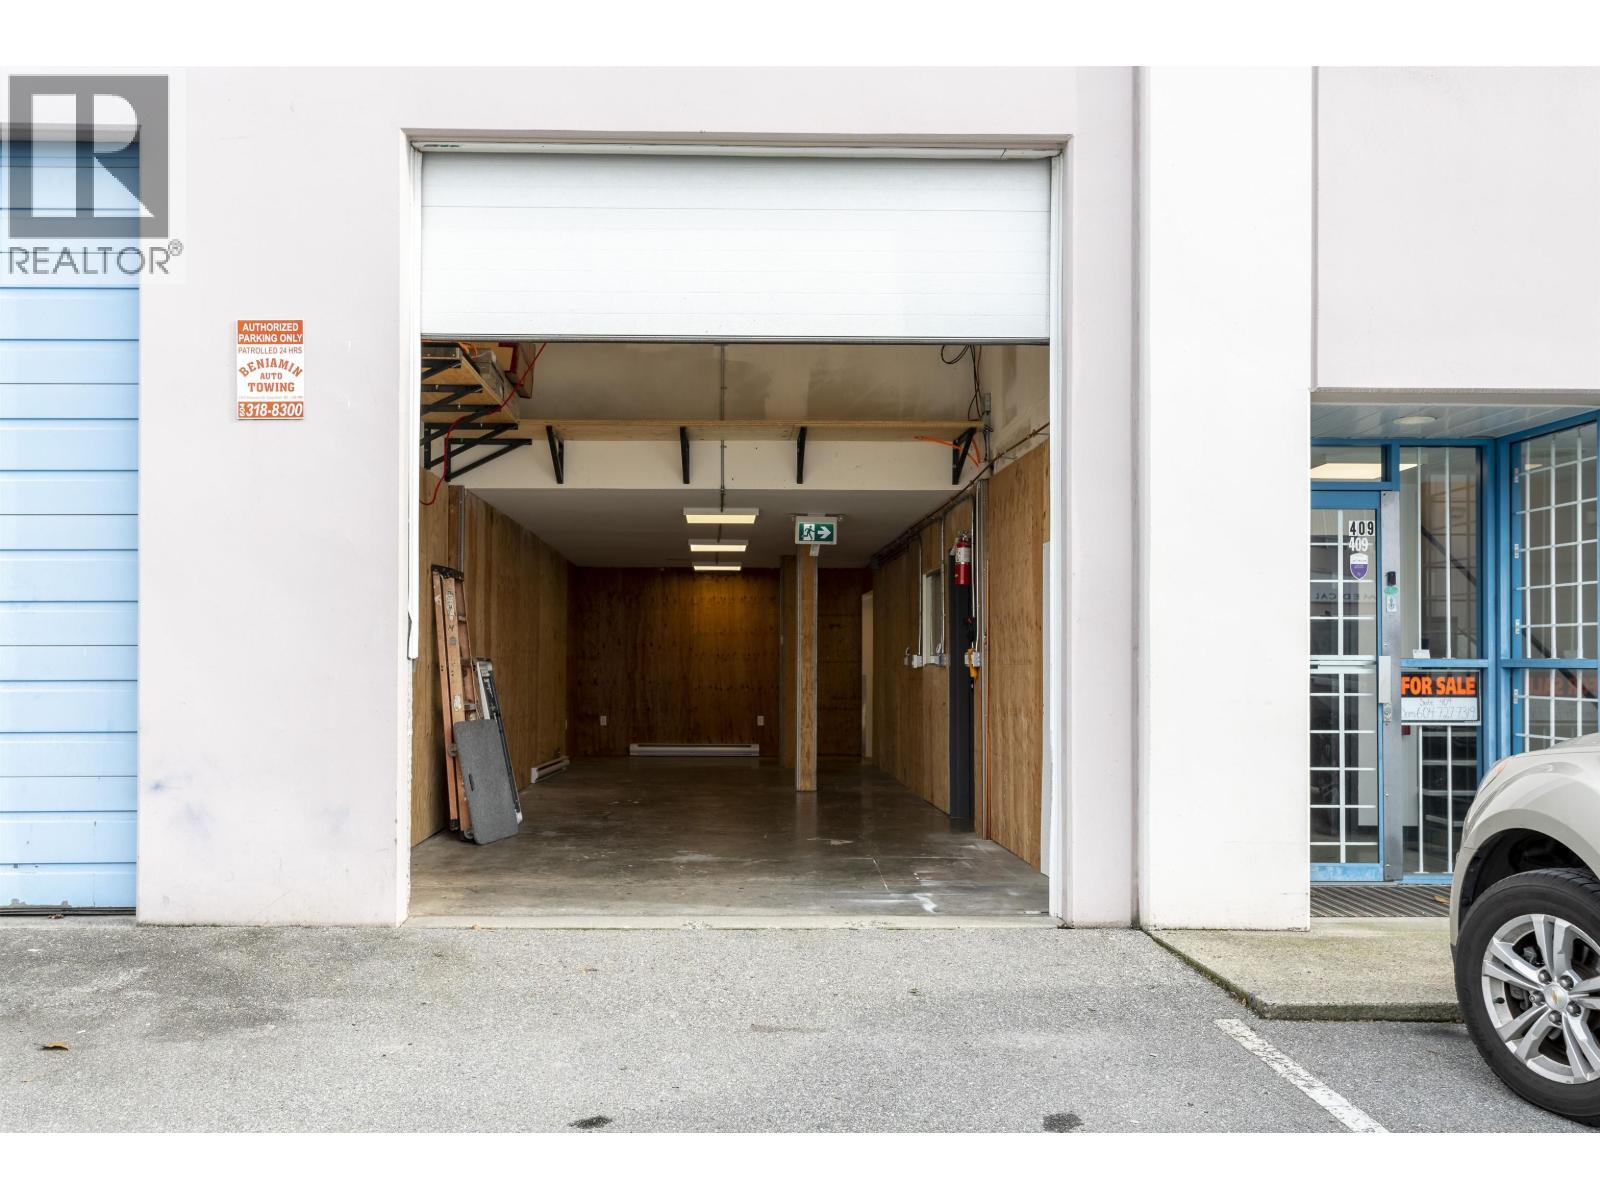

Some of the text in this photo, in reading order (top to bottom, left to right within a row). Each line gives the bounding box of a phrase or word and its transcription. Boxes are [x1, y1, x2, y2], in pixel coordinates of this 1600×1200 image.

[242, 322, 299, 332] AUTHORIZED
[238, 333, 303, 343] PARKING ONLY
[238, 346, 303, 355] PATROLLED 24 HRS
[238, 357, 303, 378] BENJAMIN
[259, 372, 283, 380] AUTO
[247, 382, 295, 393] TOWING
[1349, 520, 1374, 536] 409
[1348, 537, 1369, 552] 409
[1400, 676, 1476, 696] FOR SALE
